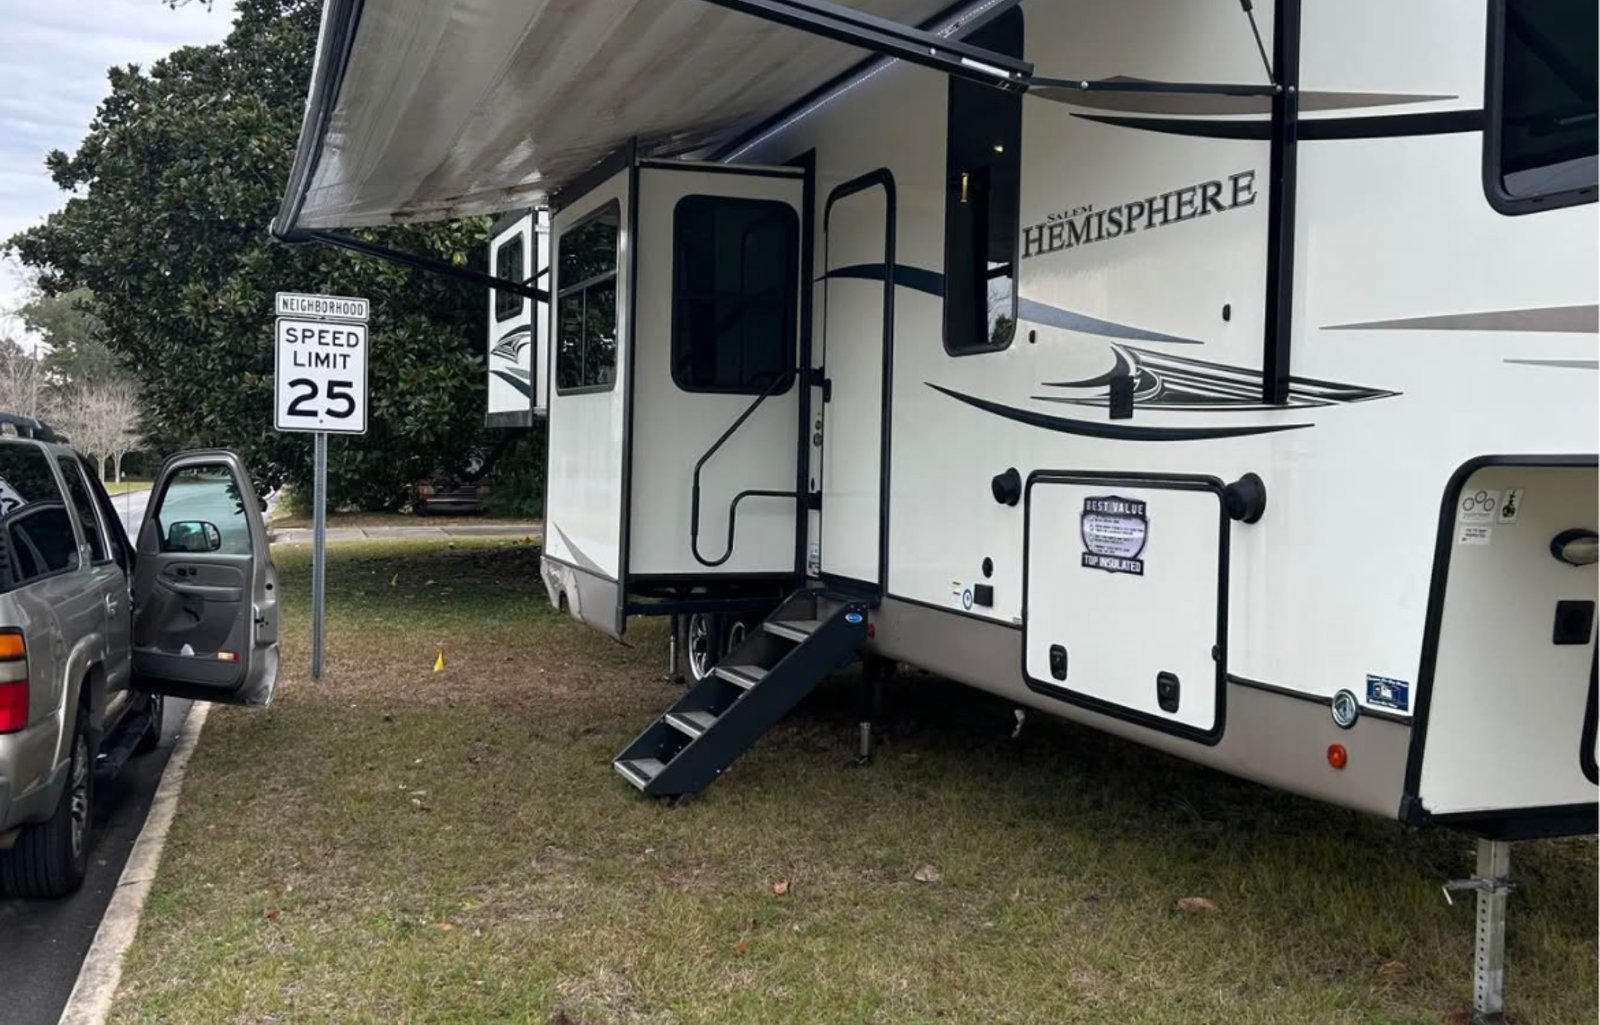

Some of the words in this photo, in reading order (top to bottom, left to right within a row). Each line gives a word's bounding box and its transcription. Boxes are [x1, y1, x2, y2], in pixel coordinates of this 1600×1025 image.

[1021, 169, 1257, 259] HEMISPHERE
[1047, 204, 1093, 223] SALEM
[282, 298, 363, 316] NEIGHBORHOOD
[285, 327, 359, 348] SPEED
[294, 350, 351, 369] LIMIT
[286, 378, 356, 419] 25
[1086, 500, 1109, 512] BEST
[1112, 502, 1144, 515] VALUE
[1085, 555, 1099, 567] TOP
[1100, 557, 1141, 572] INSULATED
